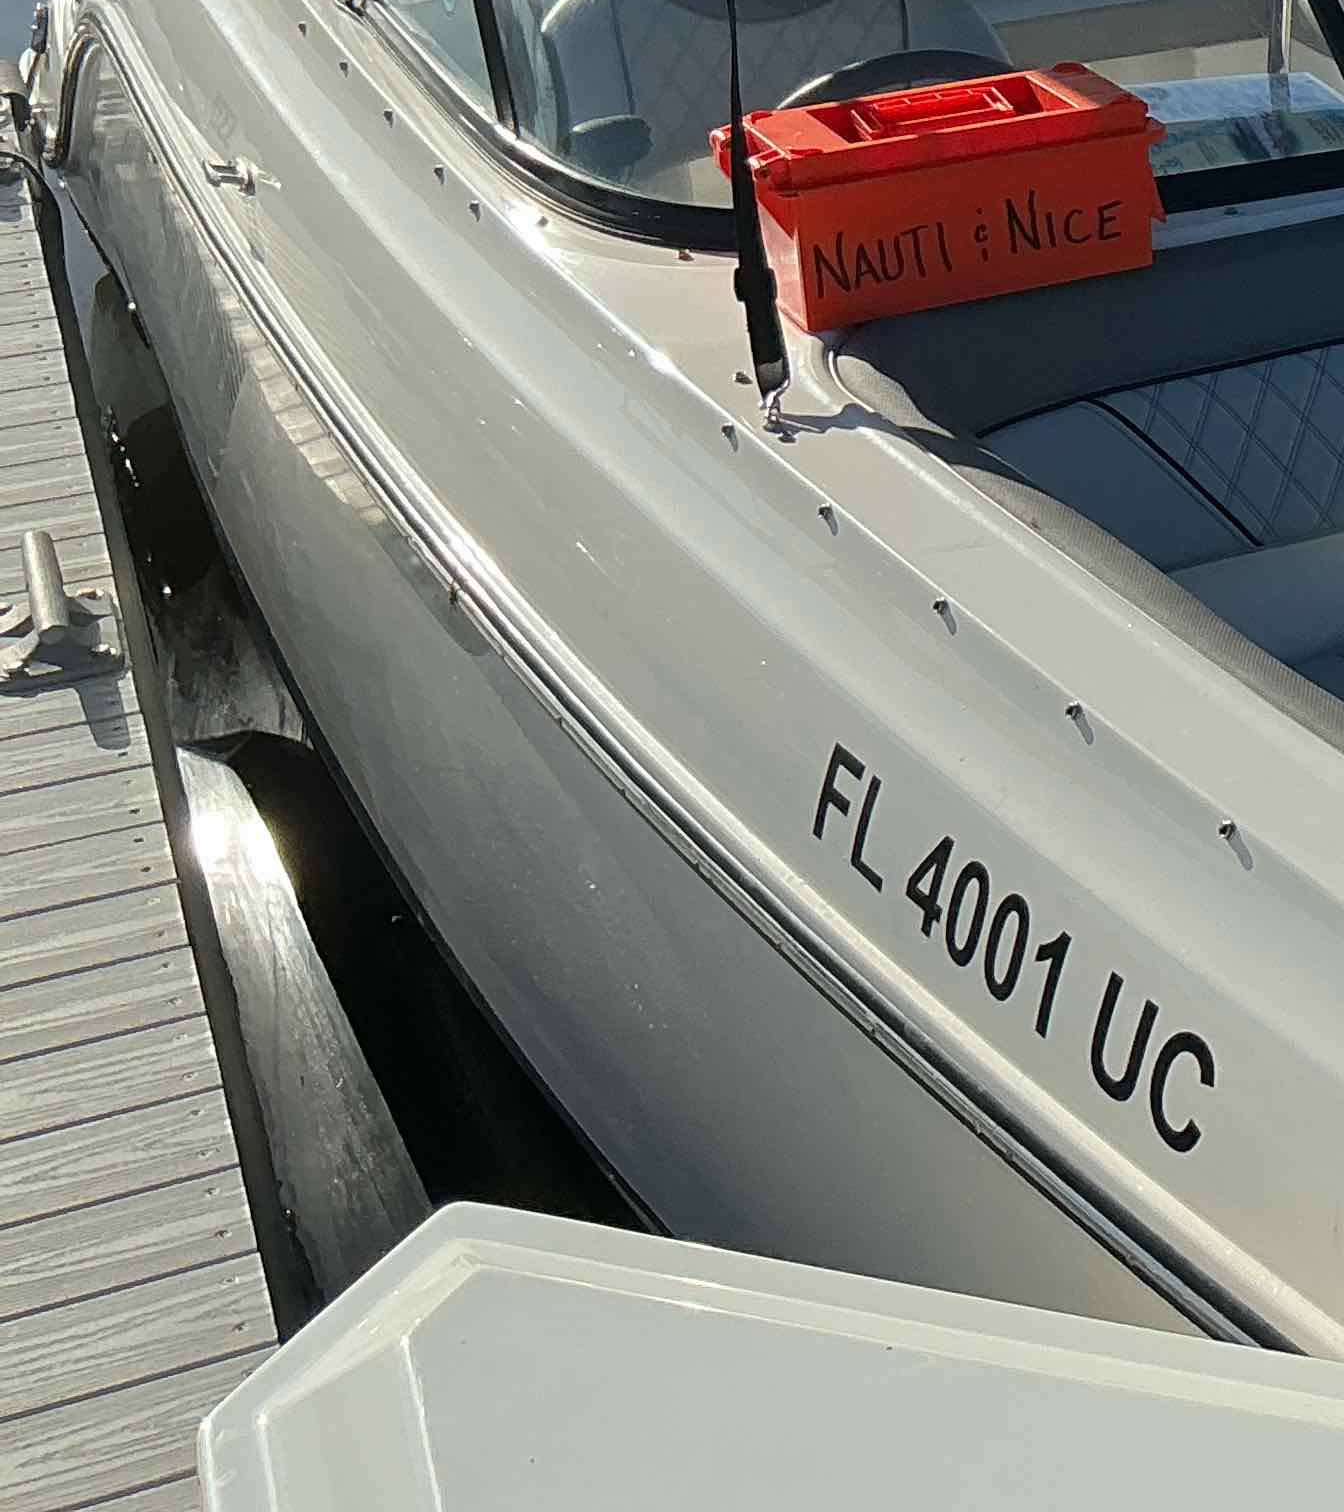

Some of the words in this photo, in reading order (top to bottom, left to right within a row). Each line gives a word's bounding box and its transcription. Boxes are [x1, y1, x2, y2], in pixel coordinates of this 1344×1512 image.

[811, 221, 953, 299] NAUTI
[1005, 190, 1124, 255] NICE
[812, 741, 884, 894] FL
[905, 835, 1073, 1040] 4001
[1090, 971, 1215, 1154] UC
